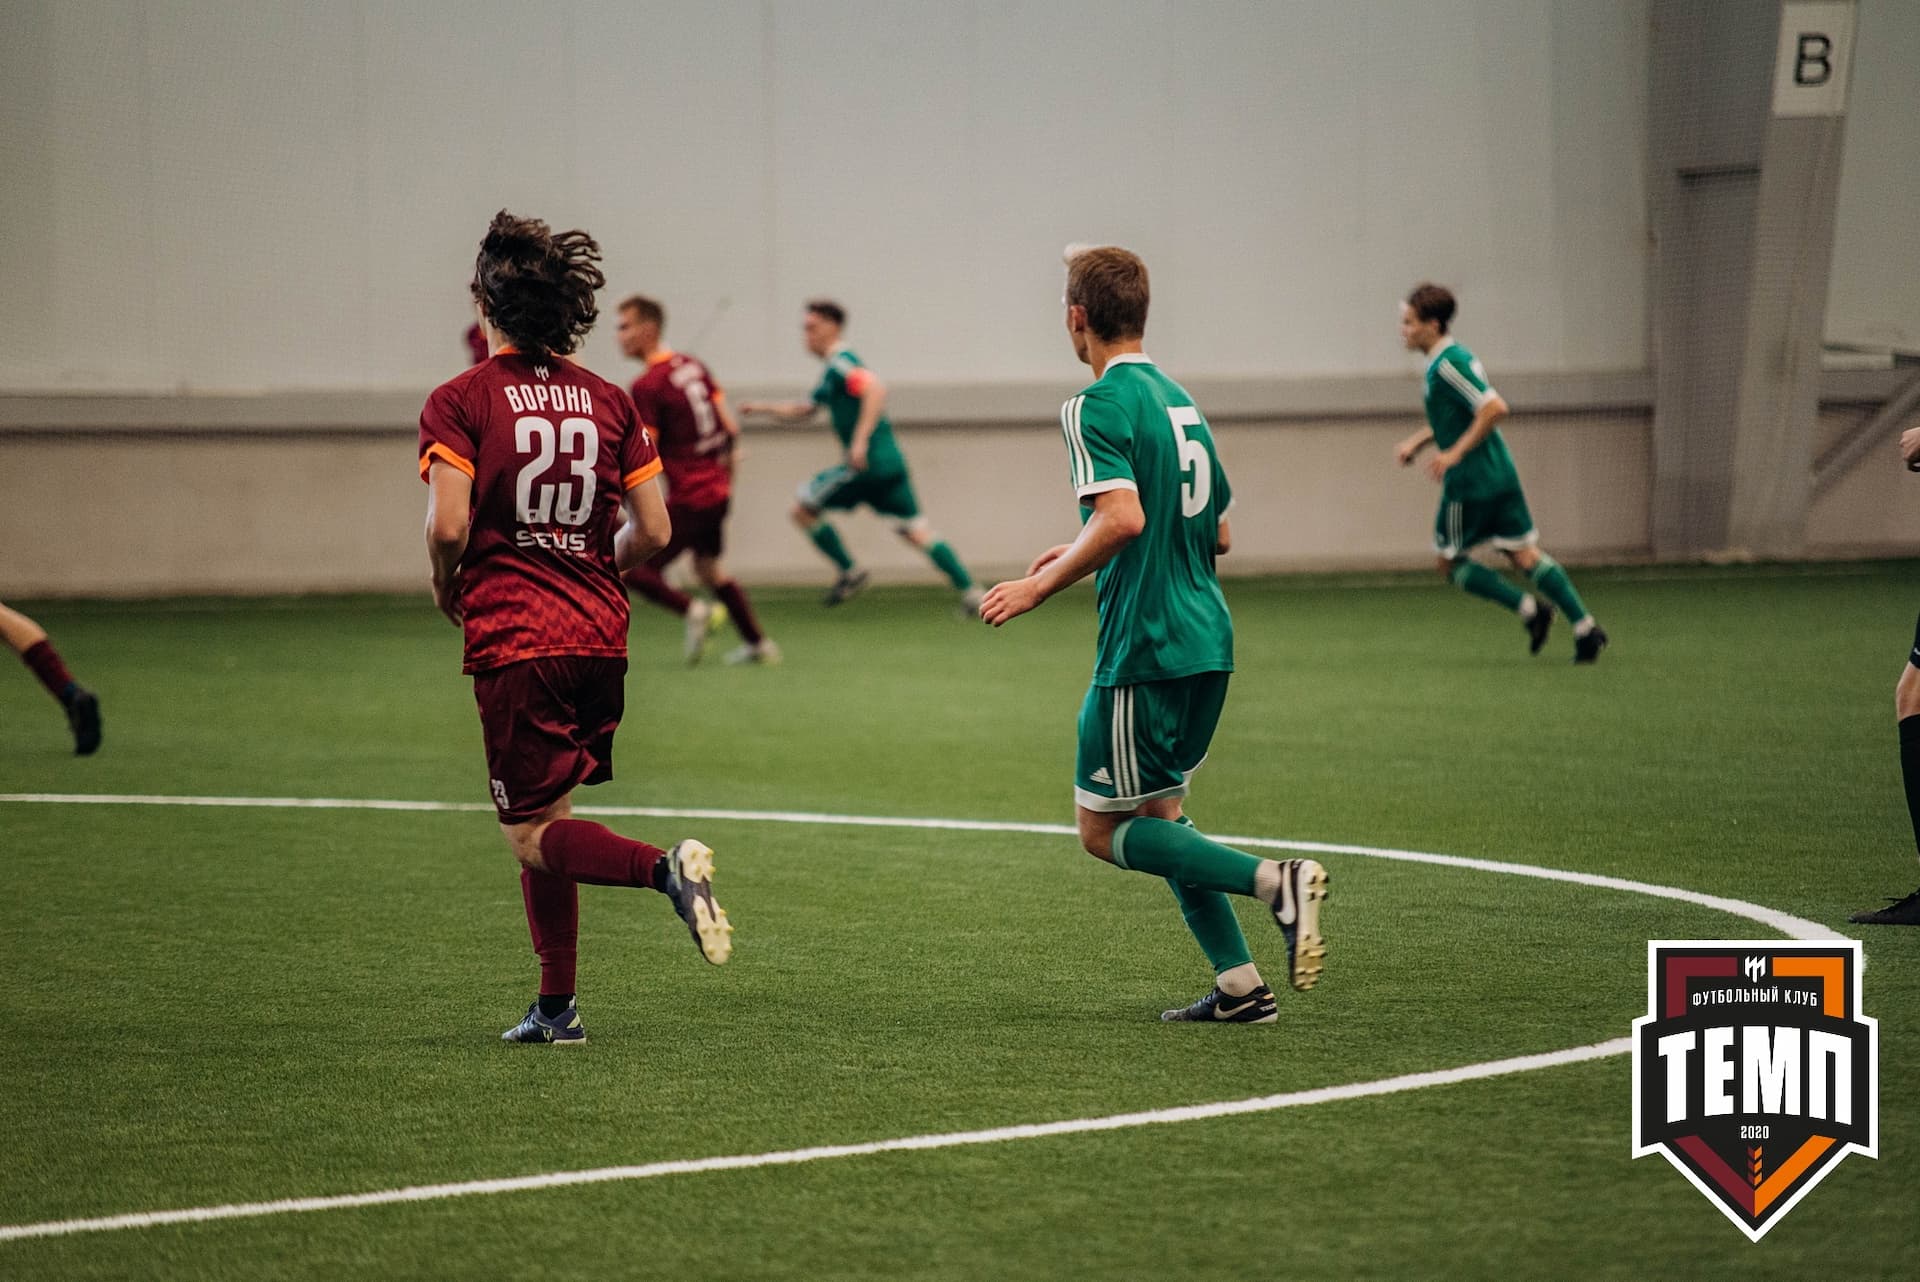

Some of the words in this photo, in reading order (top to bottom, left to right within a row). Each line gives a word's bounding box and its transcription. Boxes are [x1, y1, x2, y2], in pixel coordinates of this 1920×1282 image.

[1795, 34, 1831, 87] B
[504, 384, 593, 415] ВОРОНА
[514, 416, 599, 526] 23
[1166, 406, 1211, 518] 5
